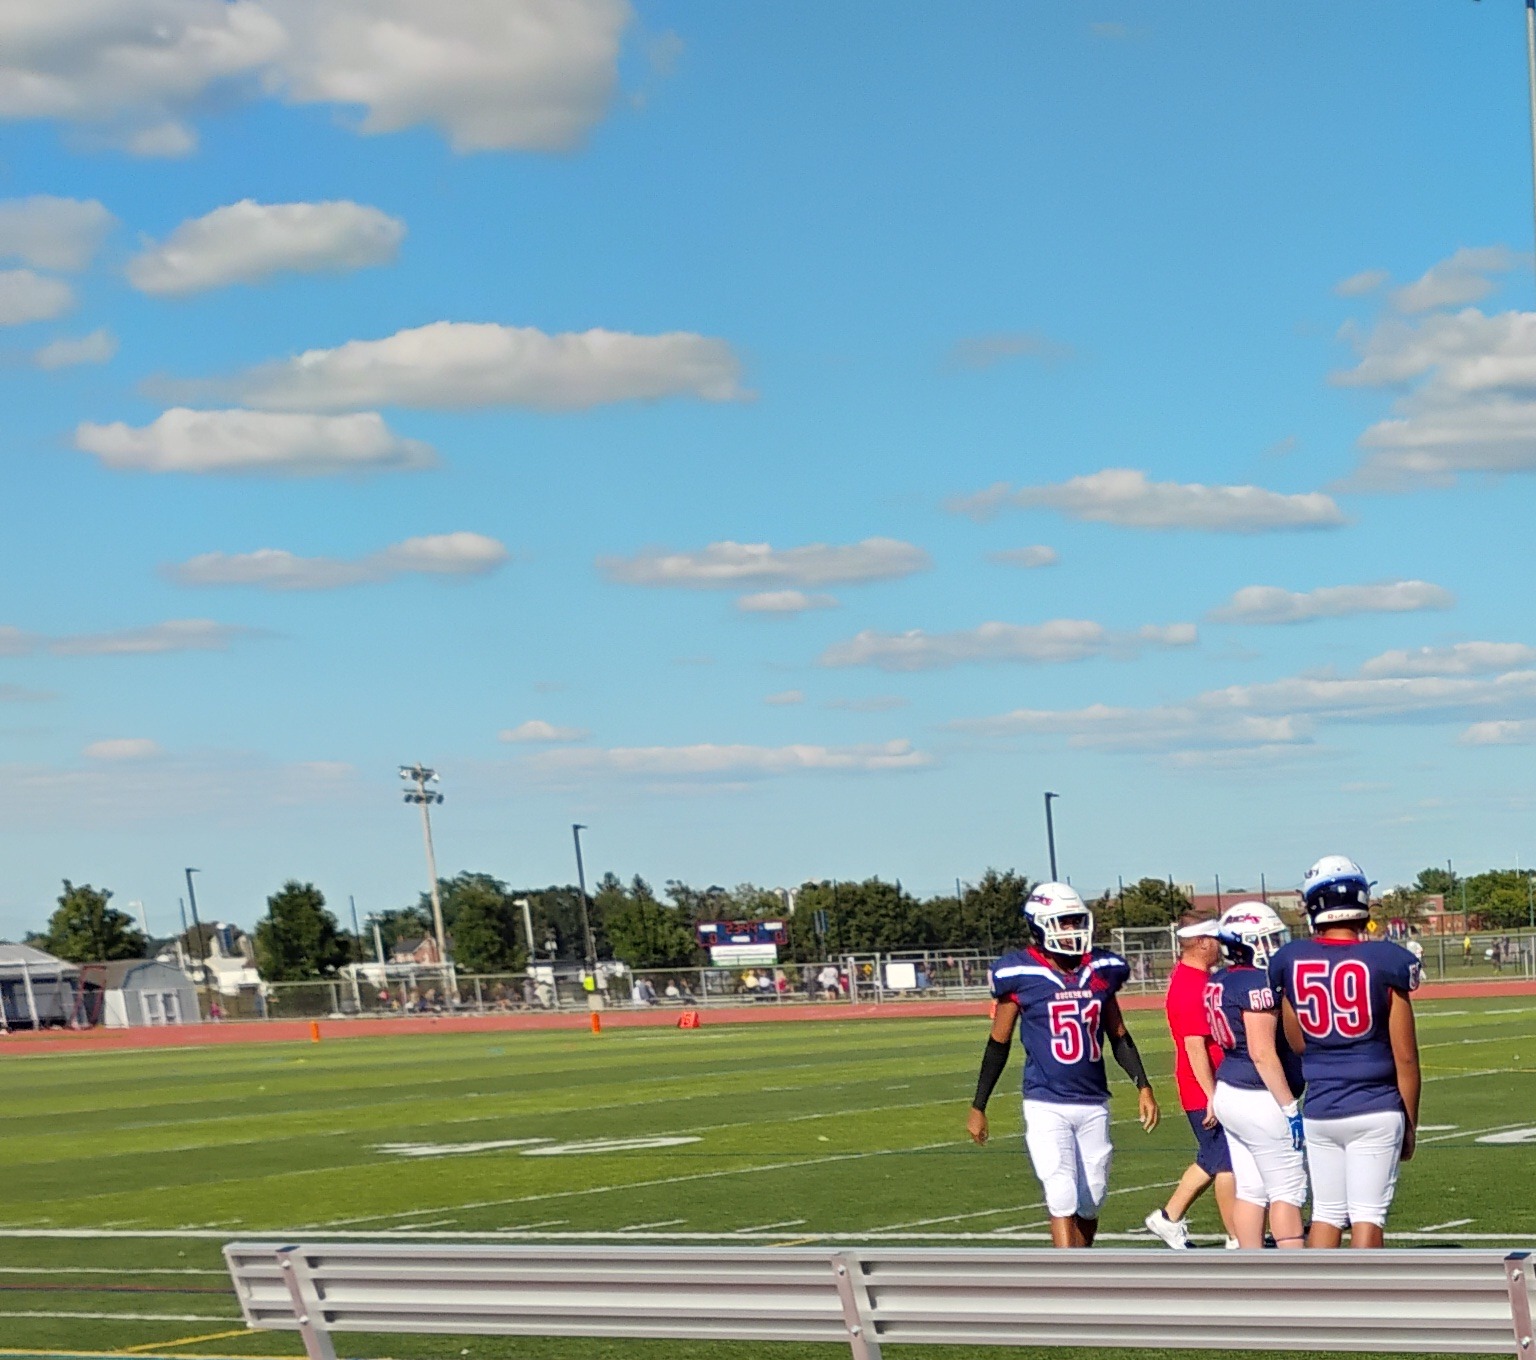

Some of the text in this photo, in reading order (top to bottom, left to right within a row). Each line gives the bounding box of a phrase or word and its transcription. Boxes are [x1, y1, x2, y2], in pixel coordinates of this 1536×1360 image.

[1249, 987, 1275, 1011] 56
[1293, 959, 1373, 1038] 59
[1048, 1000, 1102, 1065] 51
